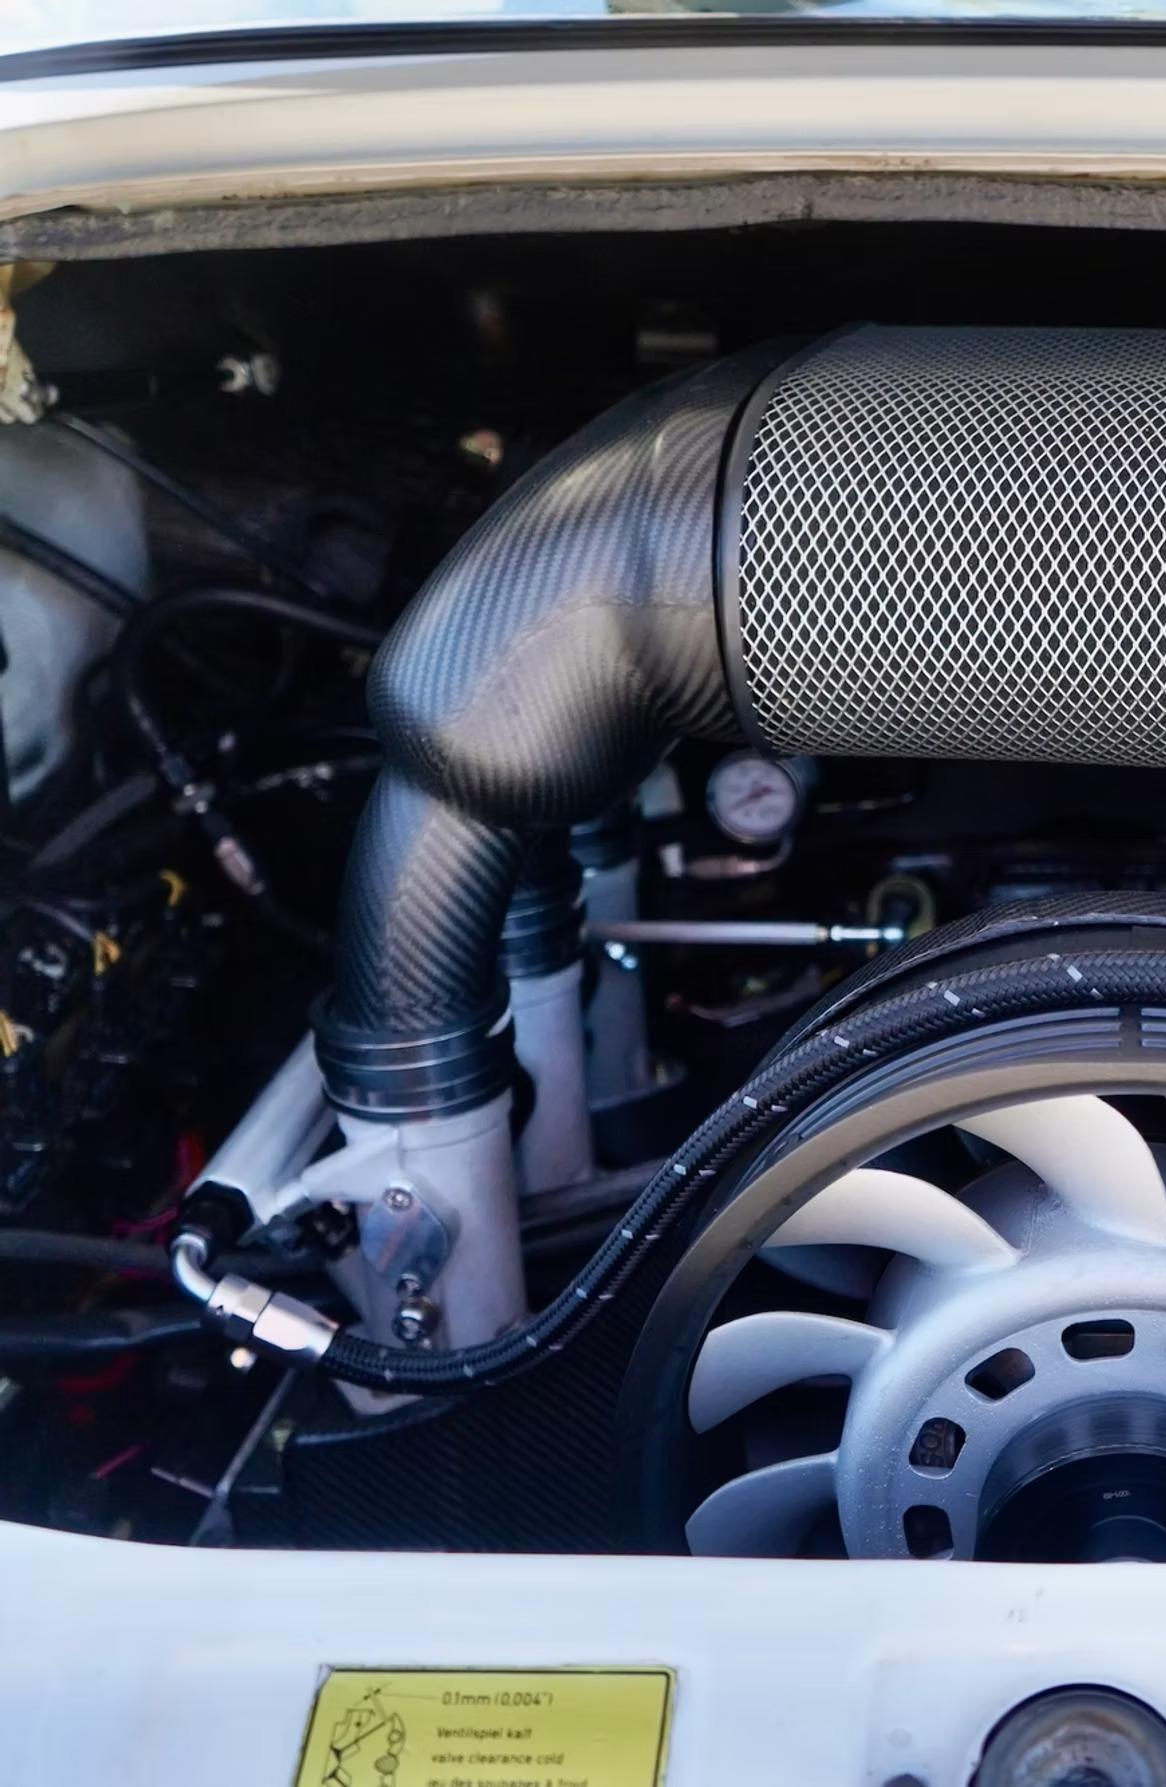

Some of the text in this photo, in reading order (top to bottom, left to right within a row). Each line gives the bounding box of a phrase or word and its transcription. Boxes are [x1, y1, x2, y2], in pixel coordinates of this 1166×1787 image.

[436, 1726, 533, 1741] Ventilspiel kalt
[431, 1752, 566, 1766] valve clearance cold
